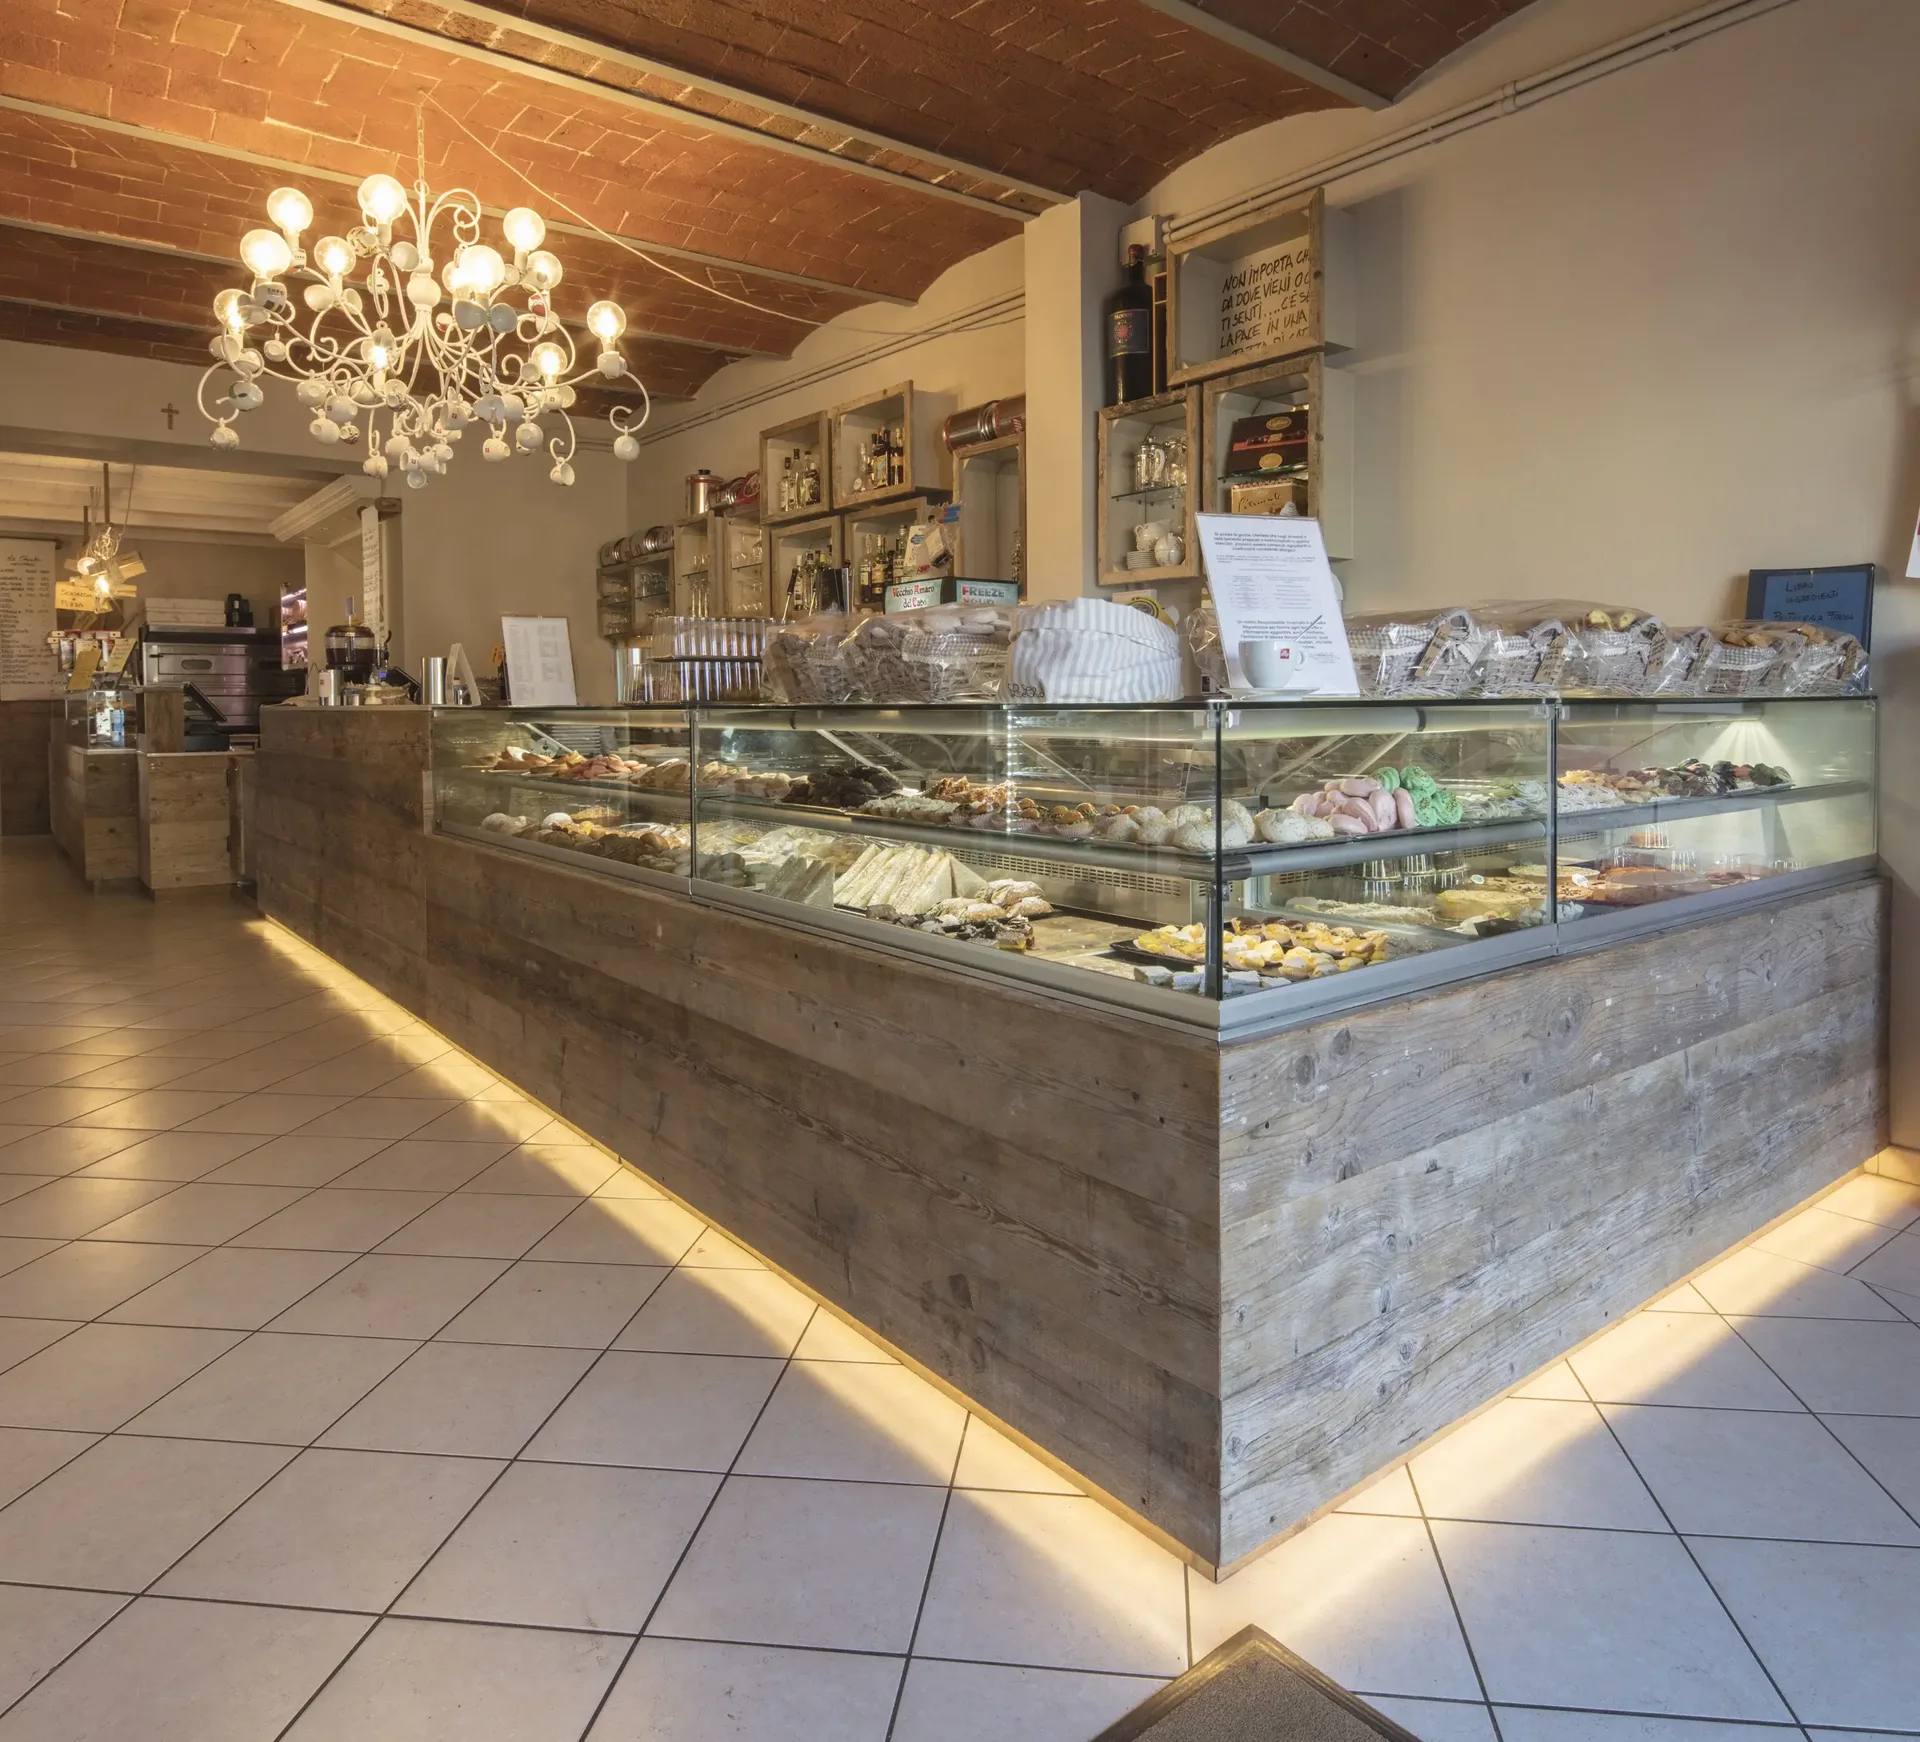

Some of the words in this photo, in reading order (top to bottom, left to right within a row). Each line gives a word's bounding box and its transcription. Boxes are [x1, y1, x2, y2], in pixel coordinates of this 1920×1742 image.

[1222, 270, 1246, 293] NON
[1248, 253, 1294, 287] IMPORTA
[1296, 248, 1310, 264] CH
[1221, 295, 1233, 312] DA
[1236, 285, 1262, 307] DOVE
[1263, 271, 1291, 299] VIENI
[1221, 316, 1231, 331] TI
[1232, 301, 1263, 327] SENTI
[1266, 317, 1280, 336] IN
[1283, 309, 1307, 328] UNA
[914, 584, 935, 595] Amaro
[962, 585, 1005, 598] FREEZE
